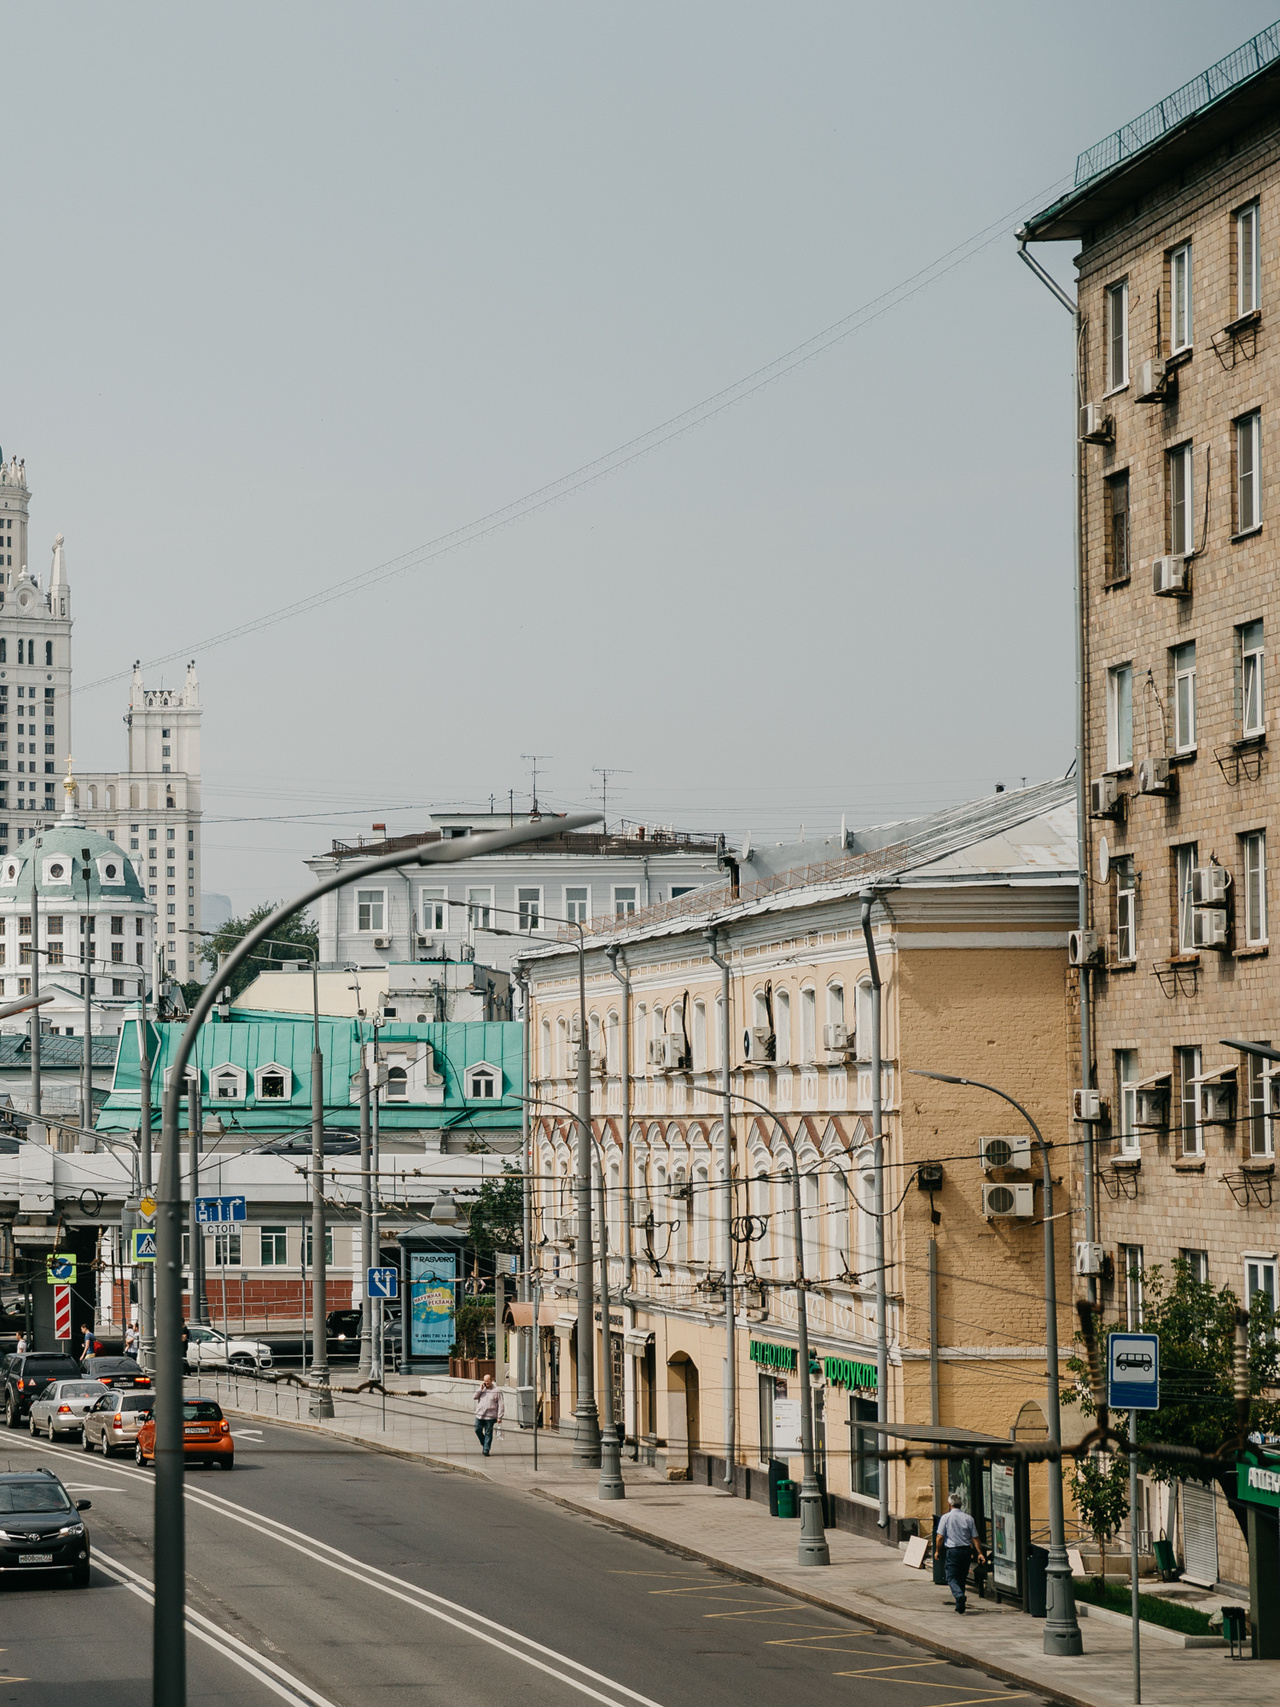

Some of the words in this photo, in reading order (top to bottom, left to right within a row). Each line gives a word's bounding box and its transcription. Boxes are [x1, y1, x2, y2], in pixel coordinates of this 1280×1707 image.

[207, 1224, 235, 1234] СТОП
[414, 1292, 442, 1303] НАРУЖНАЯ
[750, 1340, 793, 1370] МАГНОЛИЯ
[1248, 1467, 1280, 1493] АПТЕК
